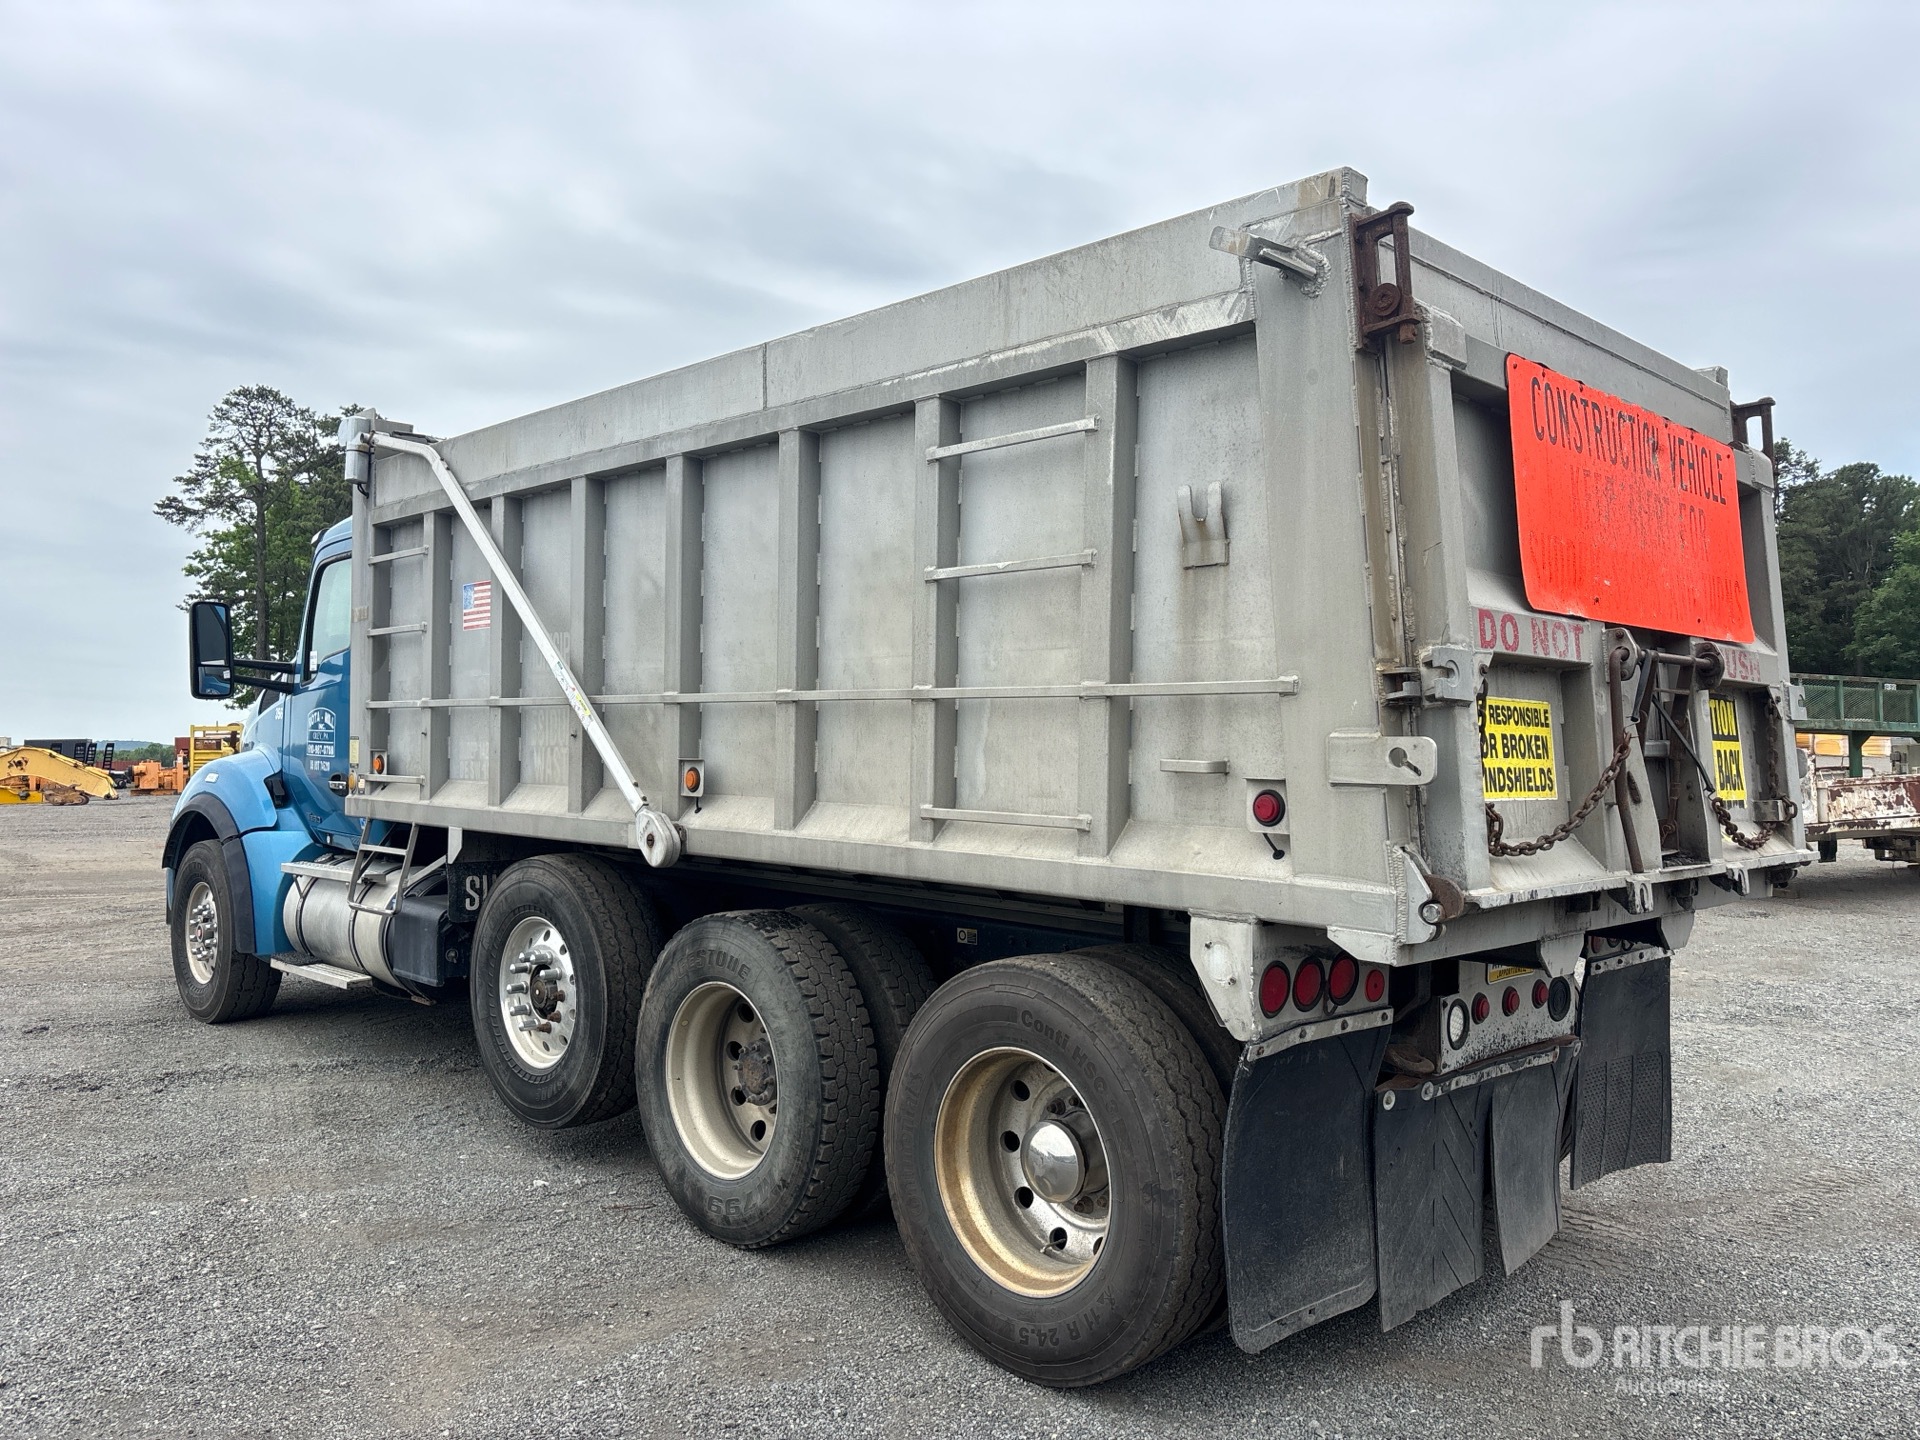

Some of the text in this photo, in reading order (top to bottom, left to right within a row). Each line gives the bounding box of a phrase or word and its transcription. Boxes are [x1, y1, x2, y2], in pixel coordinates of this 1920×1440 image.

[1531, 376, 1727, 506] CONSTRUCTION VEHICLE
[1477, 608, 1762, 683] DO NOT USH
[1488, 704, 1550, 728] RESPONSIBLE
[1709, 699, 1737, 736] TION
[1481, 732, 1550, 760] OR BROKEN
[1484, 767, 1554, 793] INDSHIELDS
[1716, 749, 1745, 791] BACK
[1021, 1010, 1070, 1047] Conti
[1018, 1327, 1060, 1347] 24.5
[1066, 1320, 1082, 1341] R
